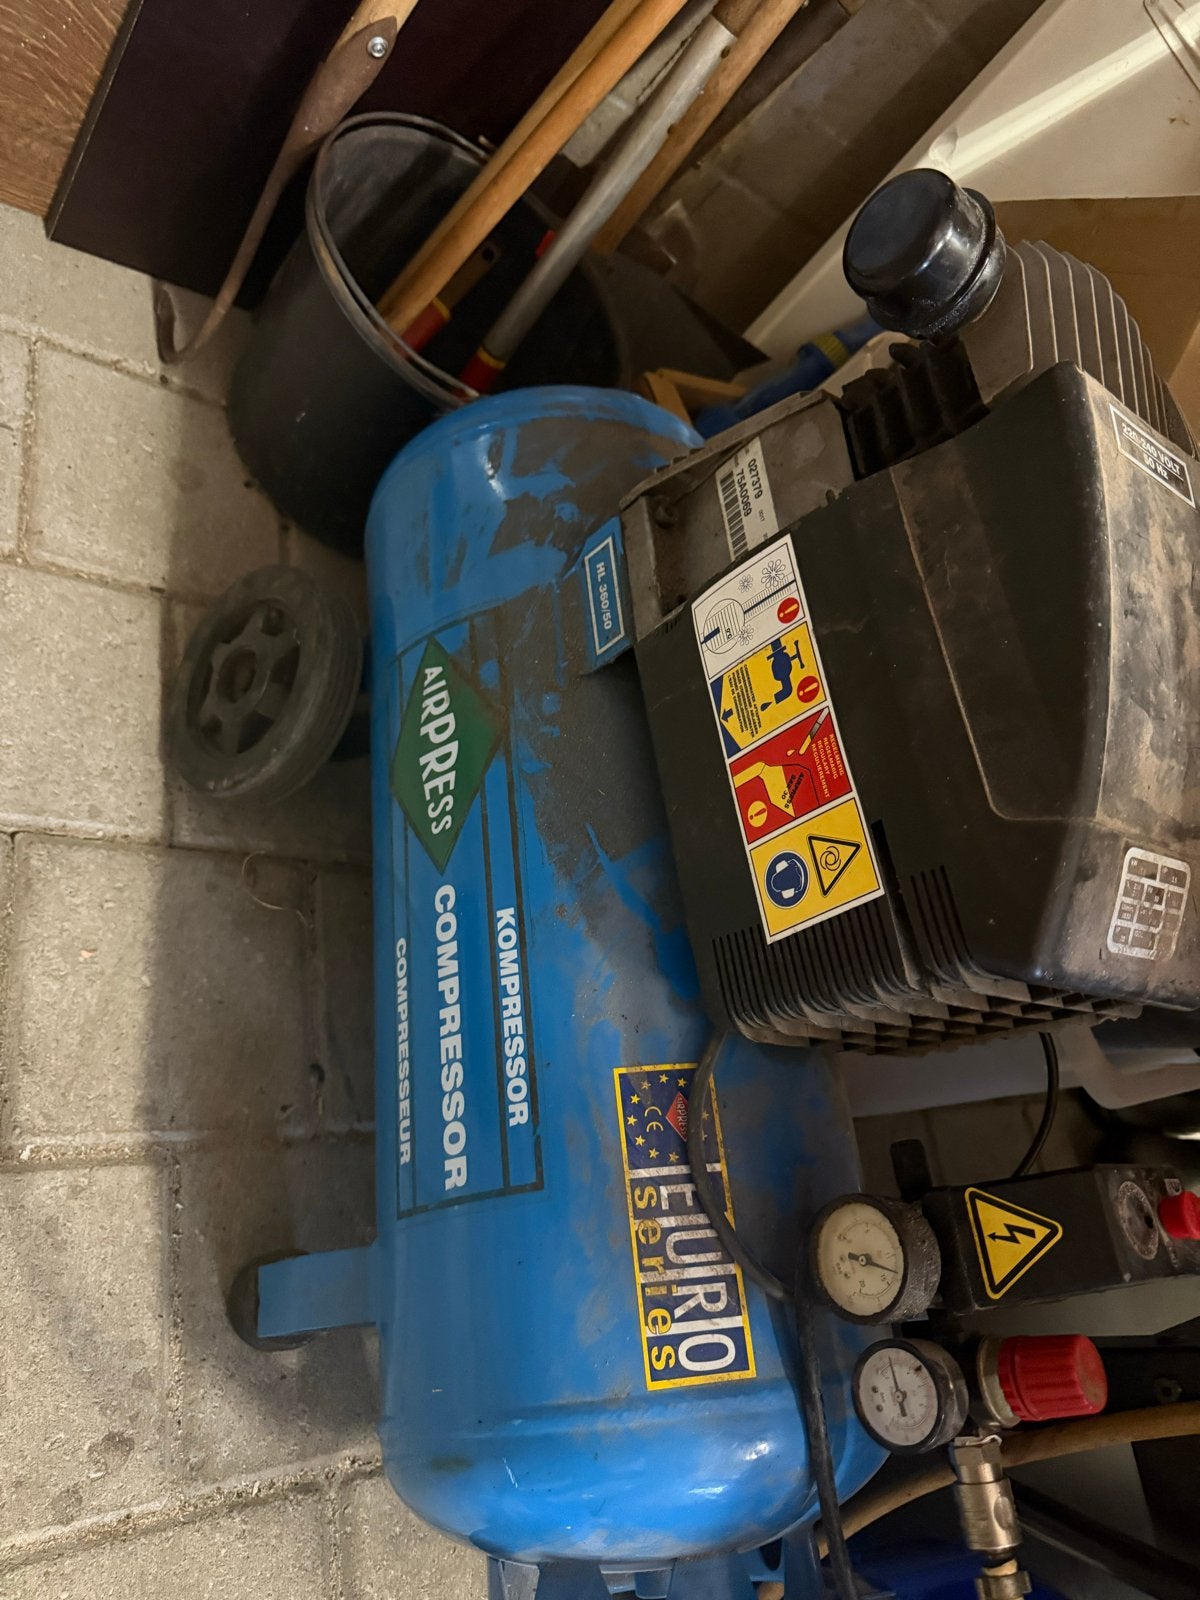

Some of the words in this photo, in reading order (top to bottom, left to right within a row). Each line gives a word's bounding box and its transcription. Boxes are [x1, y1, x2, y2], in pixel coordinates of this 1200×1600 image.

[748, 458, 763, 499] 027379
[1156, 462, 1167, 479] Hz
[1158, 450, 1179, 475] VOLT
[735, 468, 752, 517] 75A0069
[596, 562, 606, 582] HL
[599, 584, 612, 629] 360/50
[417, 666, 458, 835] AIRPRESS
[817, 739, 830, 774] REGULARY
[829, 733, 844, 775] REGELMATIG
[433, 885, 468, 1190] COMPRESSOR
[496, 907, 529, 1126] KOMPRESSOR
[395, 937, 411, 1164] COMPRESSEUR
[634, 1186, 676, 1371] series
[660, 1183, 736, 1372] EURO
